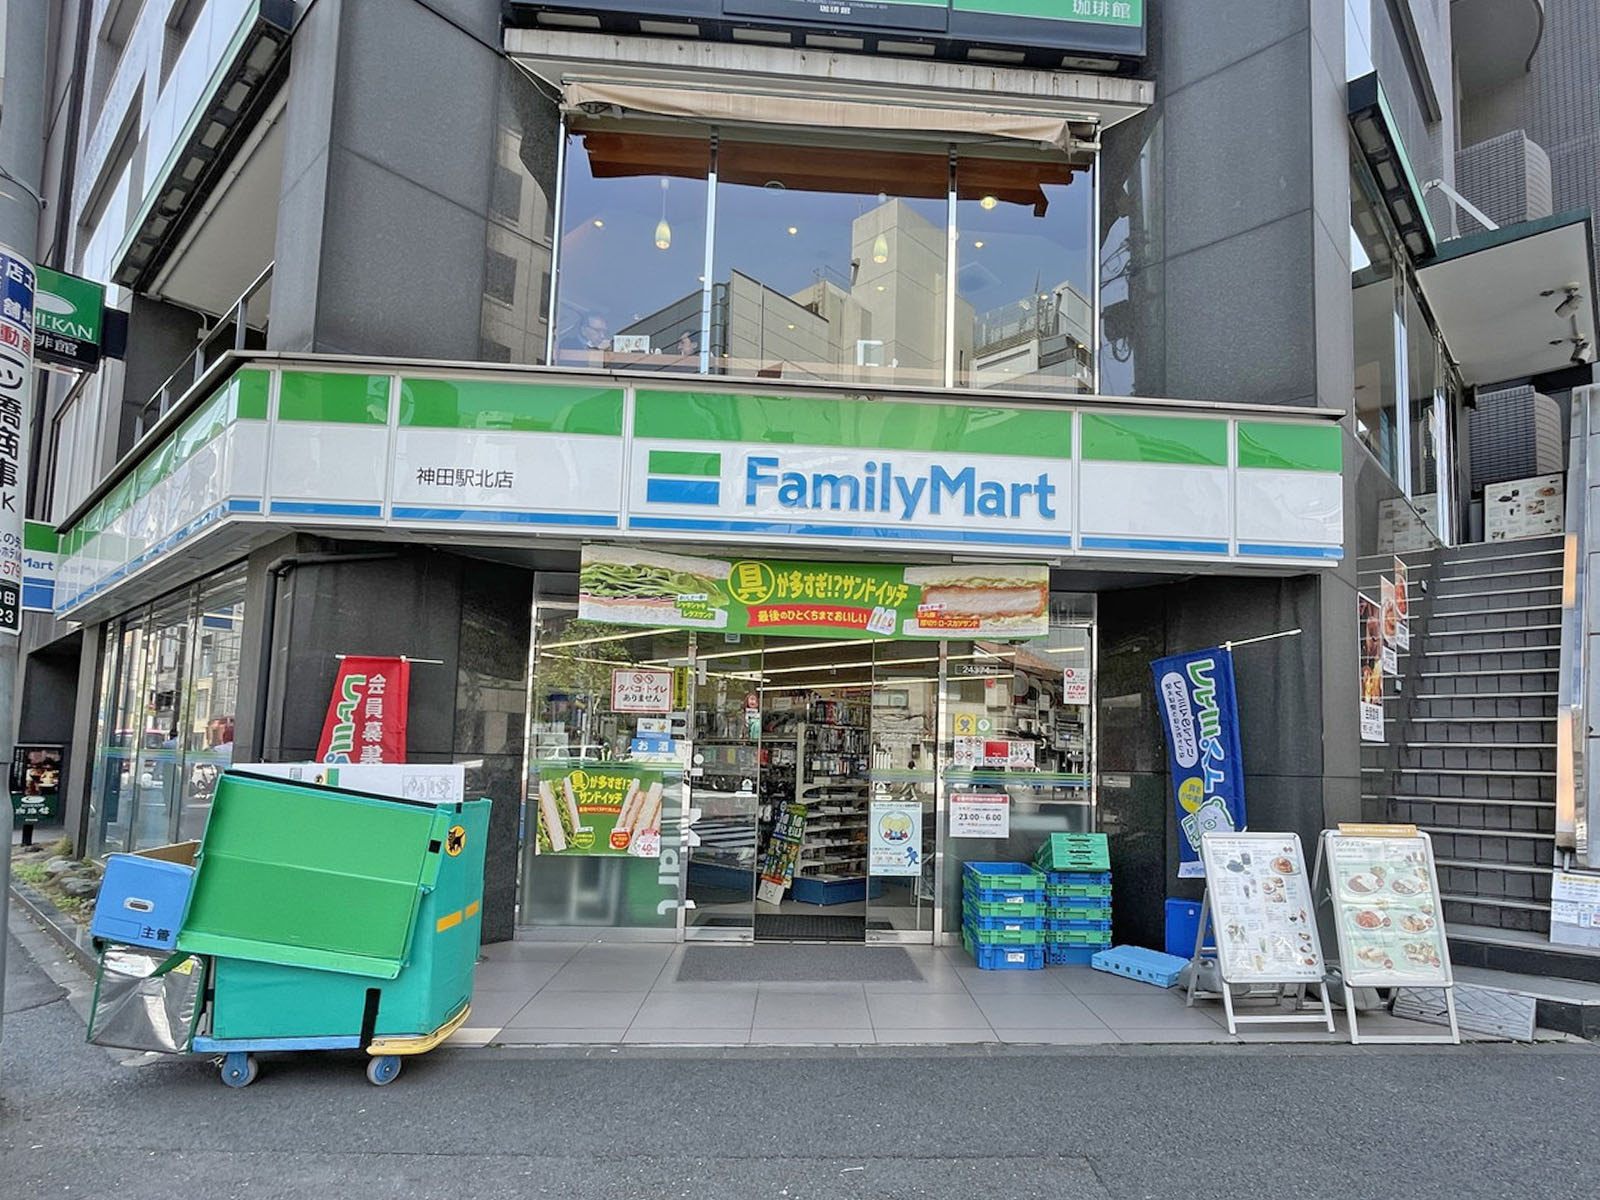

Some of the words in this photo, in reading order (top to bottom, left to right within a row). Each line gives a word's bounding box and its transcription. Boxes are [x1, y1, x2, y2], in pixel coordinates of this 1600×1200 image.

[416, 467, 514, 490] 神田駅北店
[746, 456, 1056, 519] FamilyMart
[757, 609, 867, 624] 最後のひとくちまでおいしい
[623, 694, 662, 702] ありません
[141, 926, 171, 942] 主管
